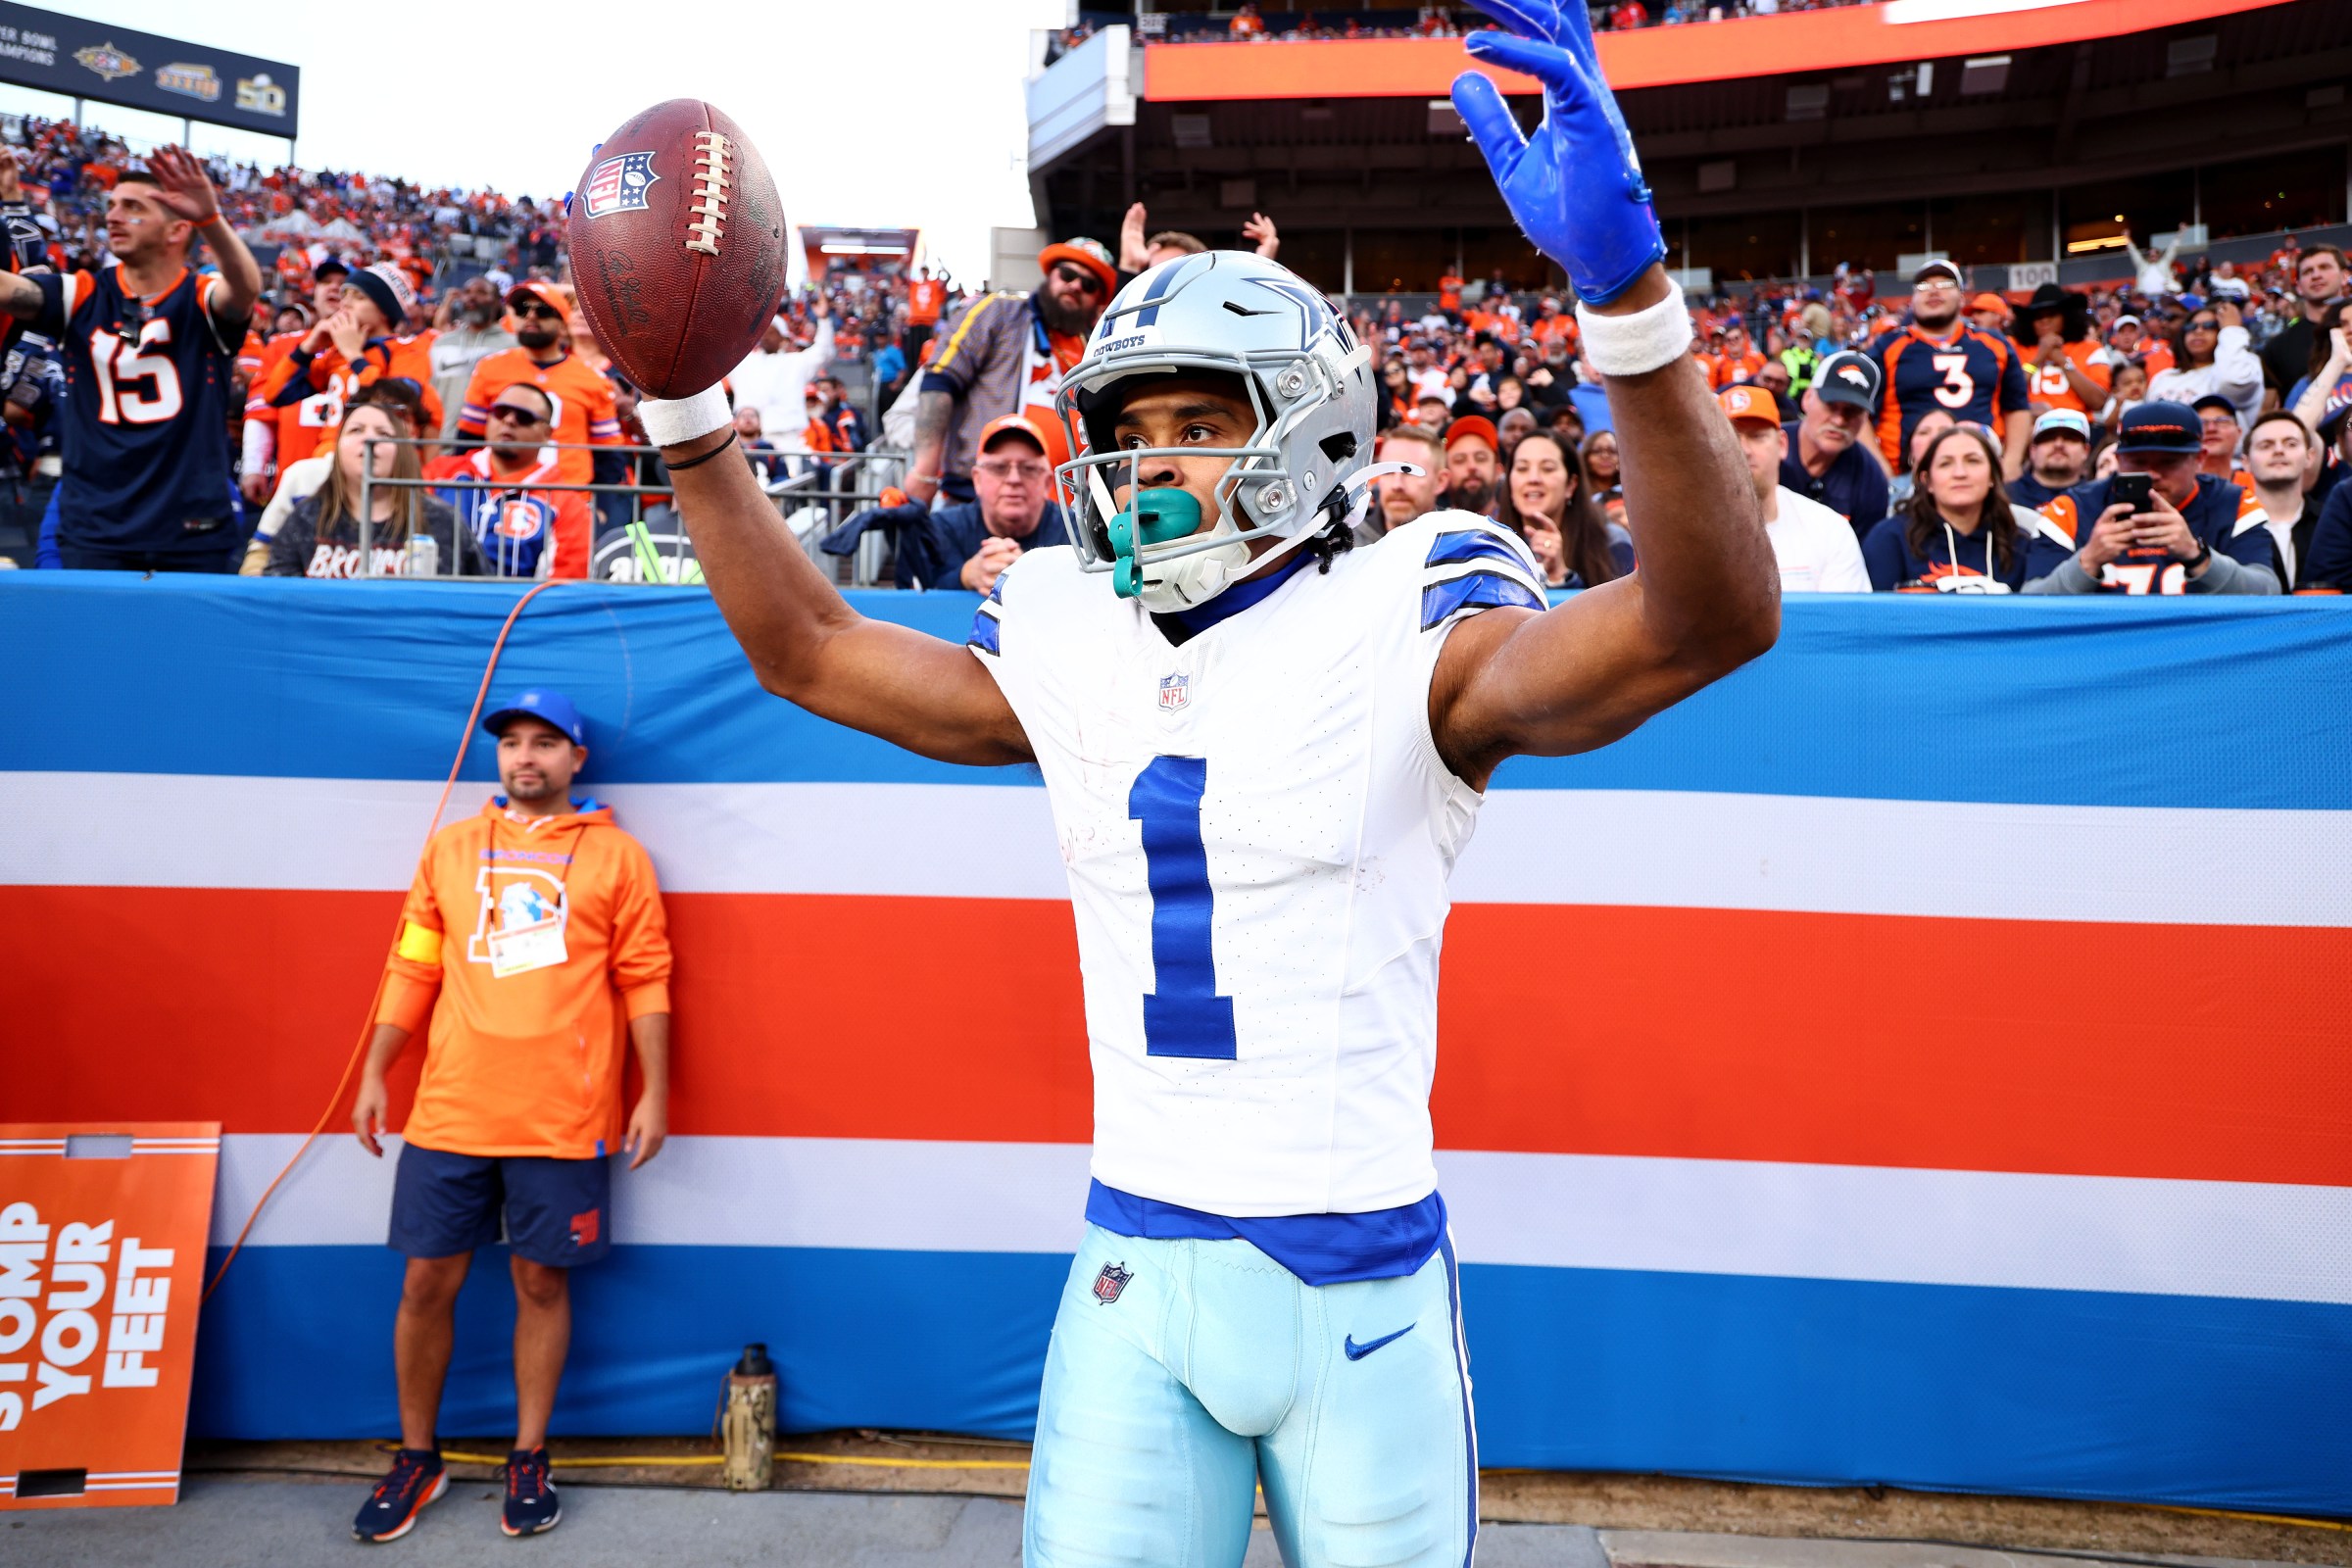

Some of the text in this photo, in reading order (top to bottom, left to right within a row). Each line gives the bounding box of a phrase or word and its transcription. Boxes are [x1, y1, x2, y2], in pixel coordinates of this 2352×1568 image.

[22, 30, 58, 51] BOWL
[236, 77, 286, 112] 50
[589, 160, 623, 212] NFL
[2015, 267, 2053, 285] 100
[1094, 334, 1146, 358] COWBOYS
[89, 316, 183, 424] 15
[1932, 354, 1975, 409] 3
[2030, 365, 2070, 395] 15
[306, 543, 408, 579] BRONCO
[1161, 688, 1185, 706] NFL
[479, 849, 574, 865] BRONCOS
[1129, 756, 1237, 1059] 1
[1096, 1276, 1118, 1297] NFL
[31, 1219, 115, 1411] YOUR
[102, 1238, 175, 1388] FEET
